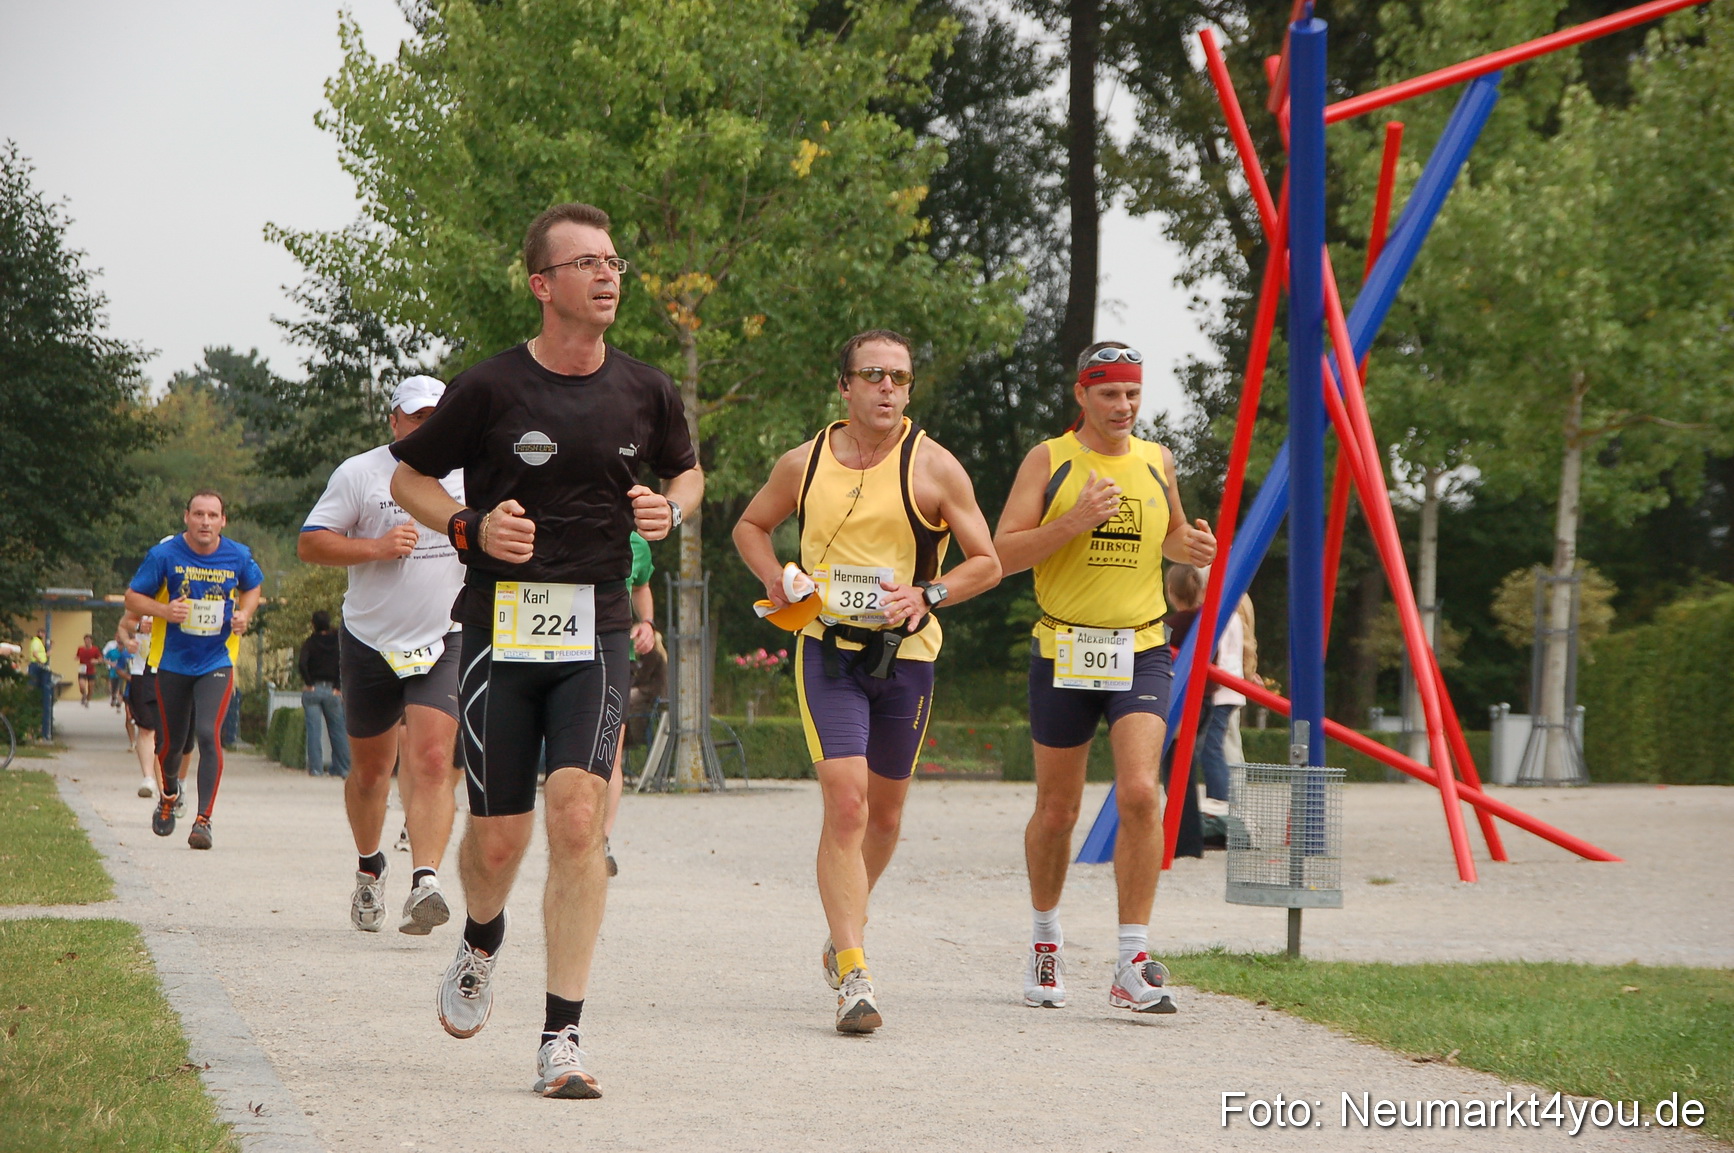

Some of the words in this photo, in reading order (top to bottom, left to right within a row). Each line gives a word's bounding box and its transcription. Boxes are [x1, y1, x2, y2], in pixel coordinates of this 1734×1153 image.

[1090, 540, 1141, 553] HIRSCH
[175, 565, 186, 574] 10.
[834, 569, 881, 584] Hermann
[523, 588, 549, 604] Karl
[839, 590, 878, 610] 382
[197, 614, 217, 624] 123
[531, 614, 578, 636] 224
[1077, 633, 1128, 645] Alexander
[1059, 649, 1065, 658] C
[1084, 651, 1119, 669] 901
